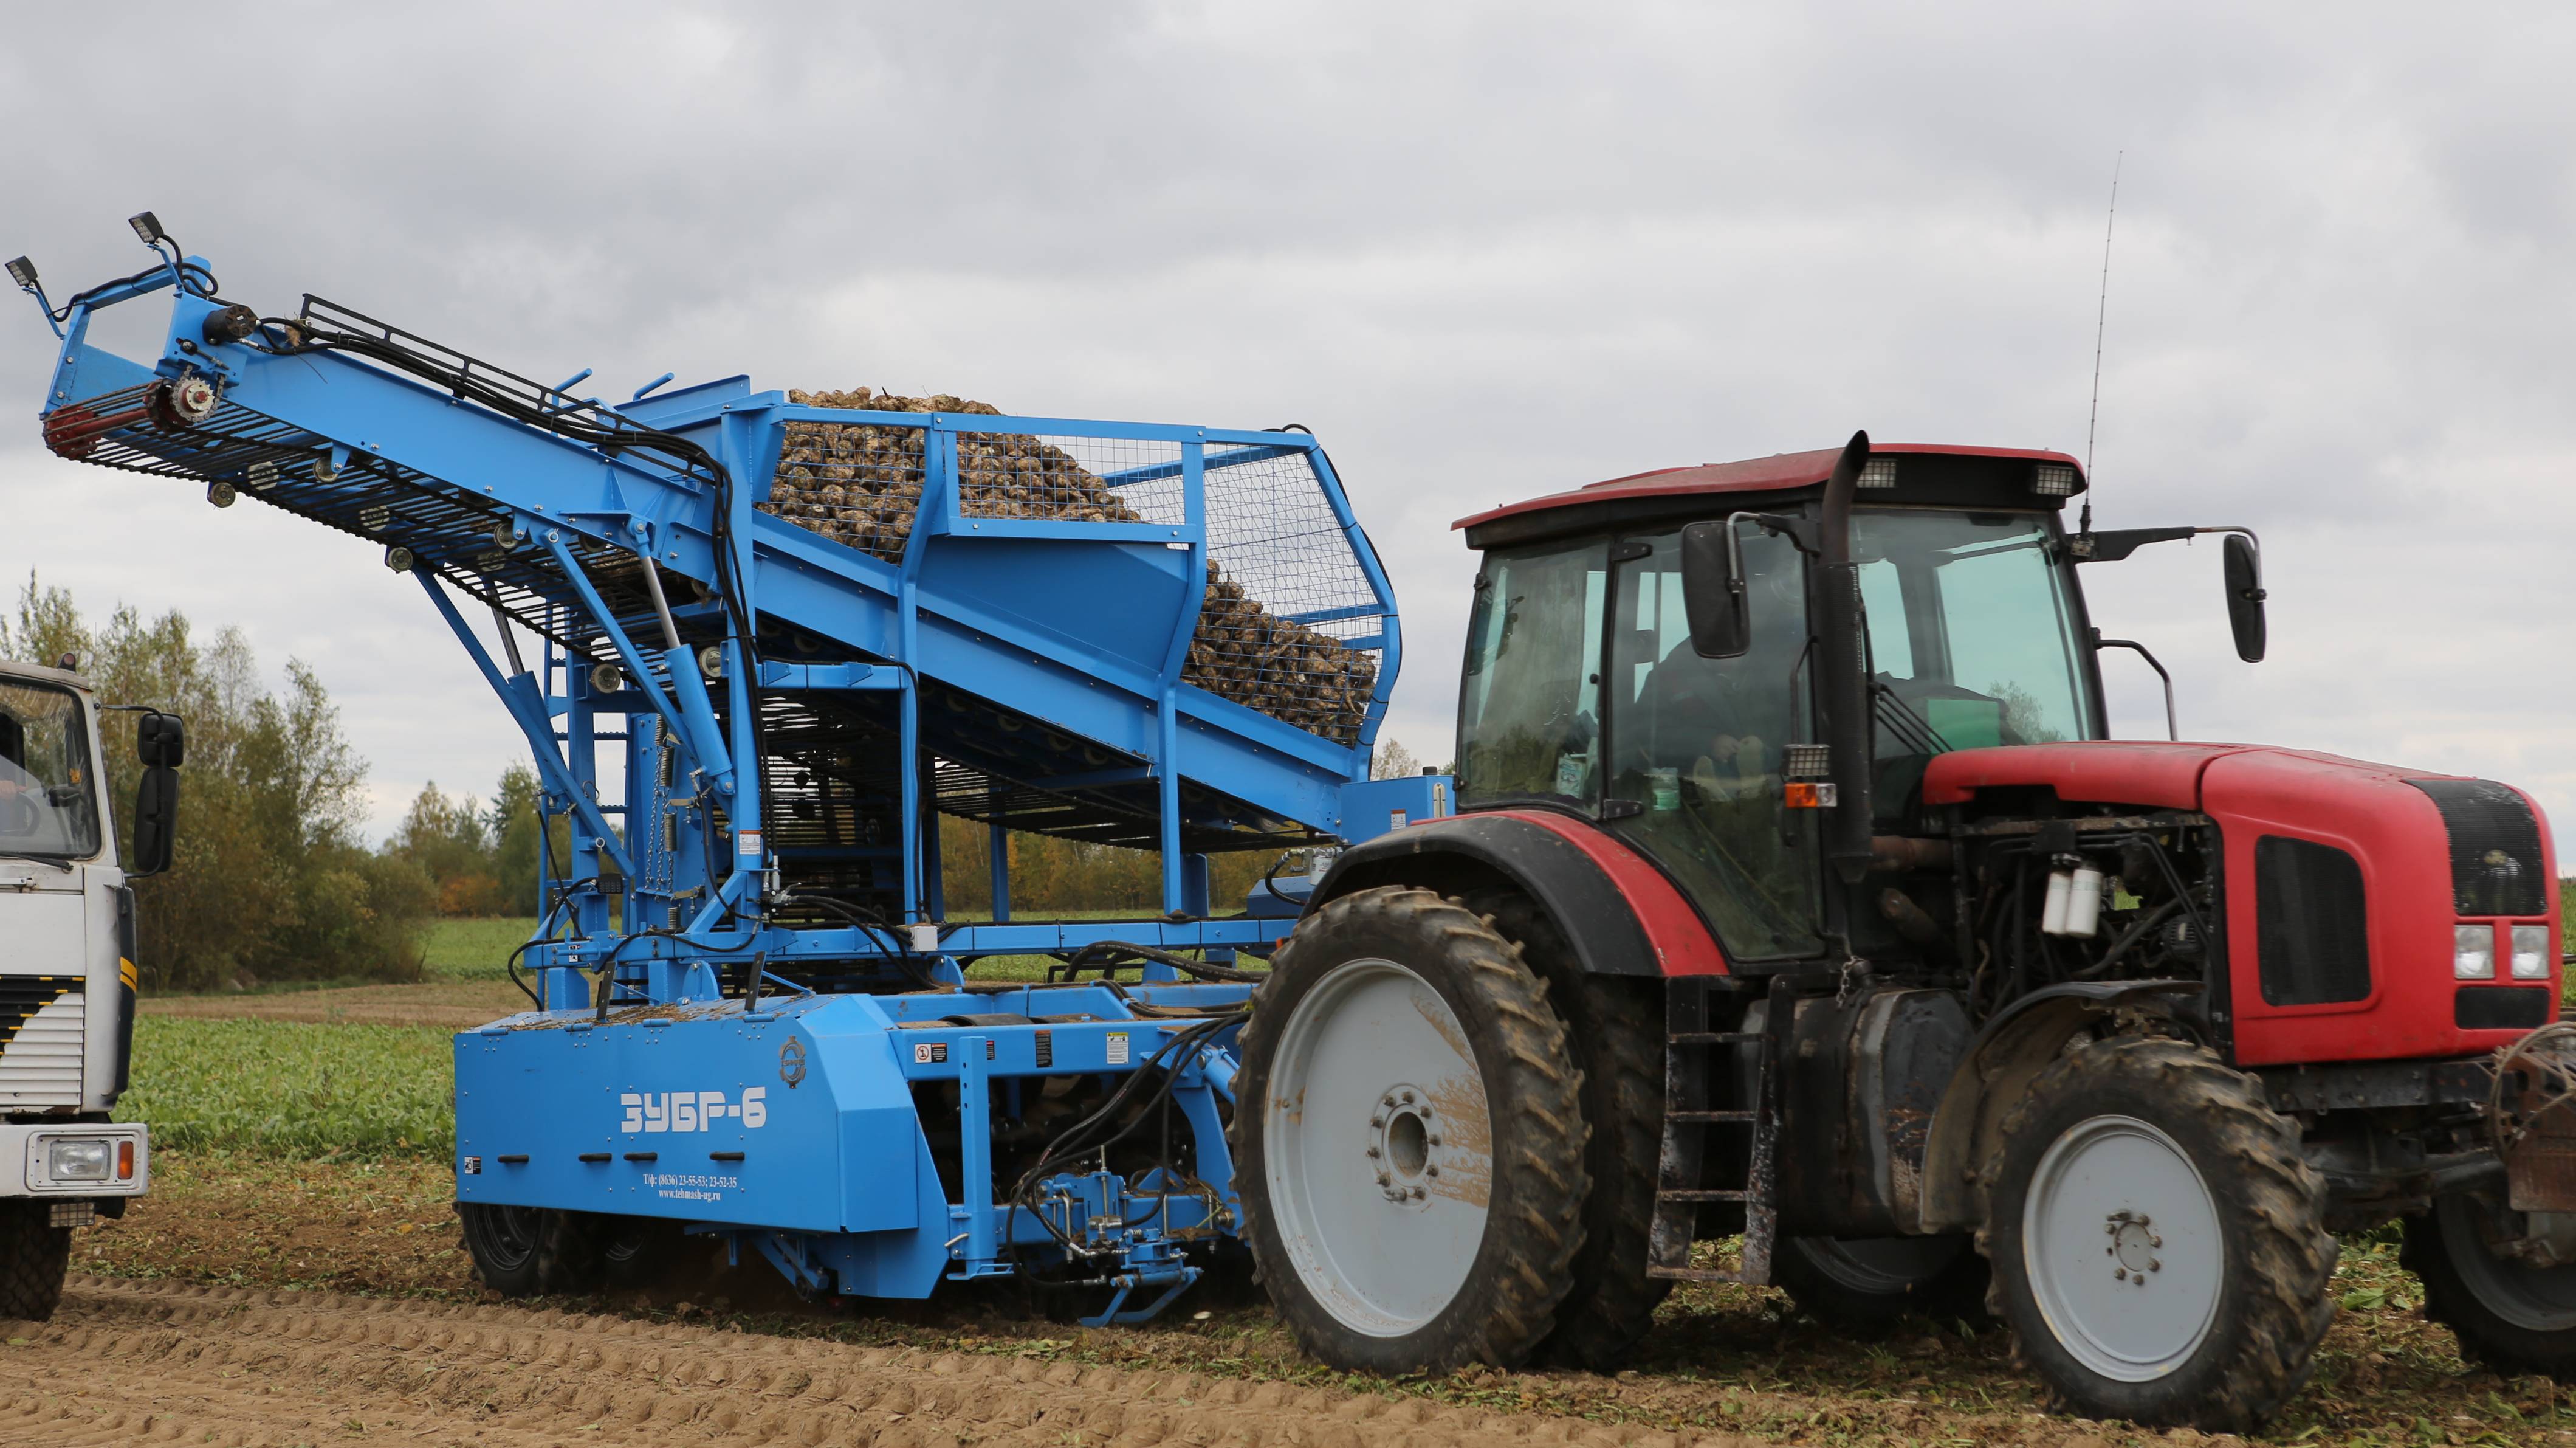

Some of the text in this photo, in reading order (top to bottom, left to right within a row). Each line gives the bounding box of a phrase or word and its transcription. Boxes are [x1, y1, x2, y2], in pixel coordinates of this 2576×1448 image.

[620, 1086, 767, 1133] ЗУБР-6
[658, 1174, 678, 1187] (8636)
[679, 1174, 707, 1188] 23-55-53;
[709, 1176, 737, 1188] 23-52-35
[659, 1188, 721, 1203] www.tehmash-ug.ru
